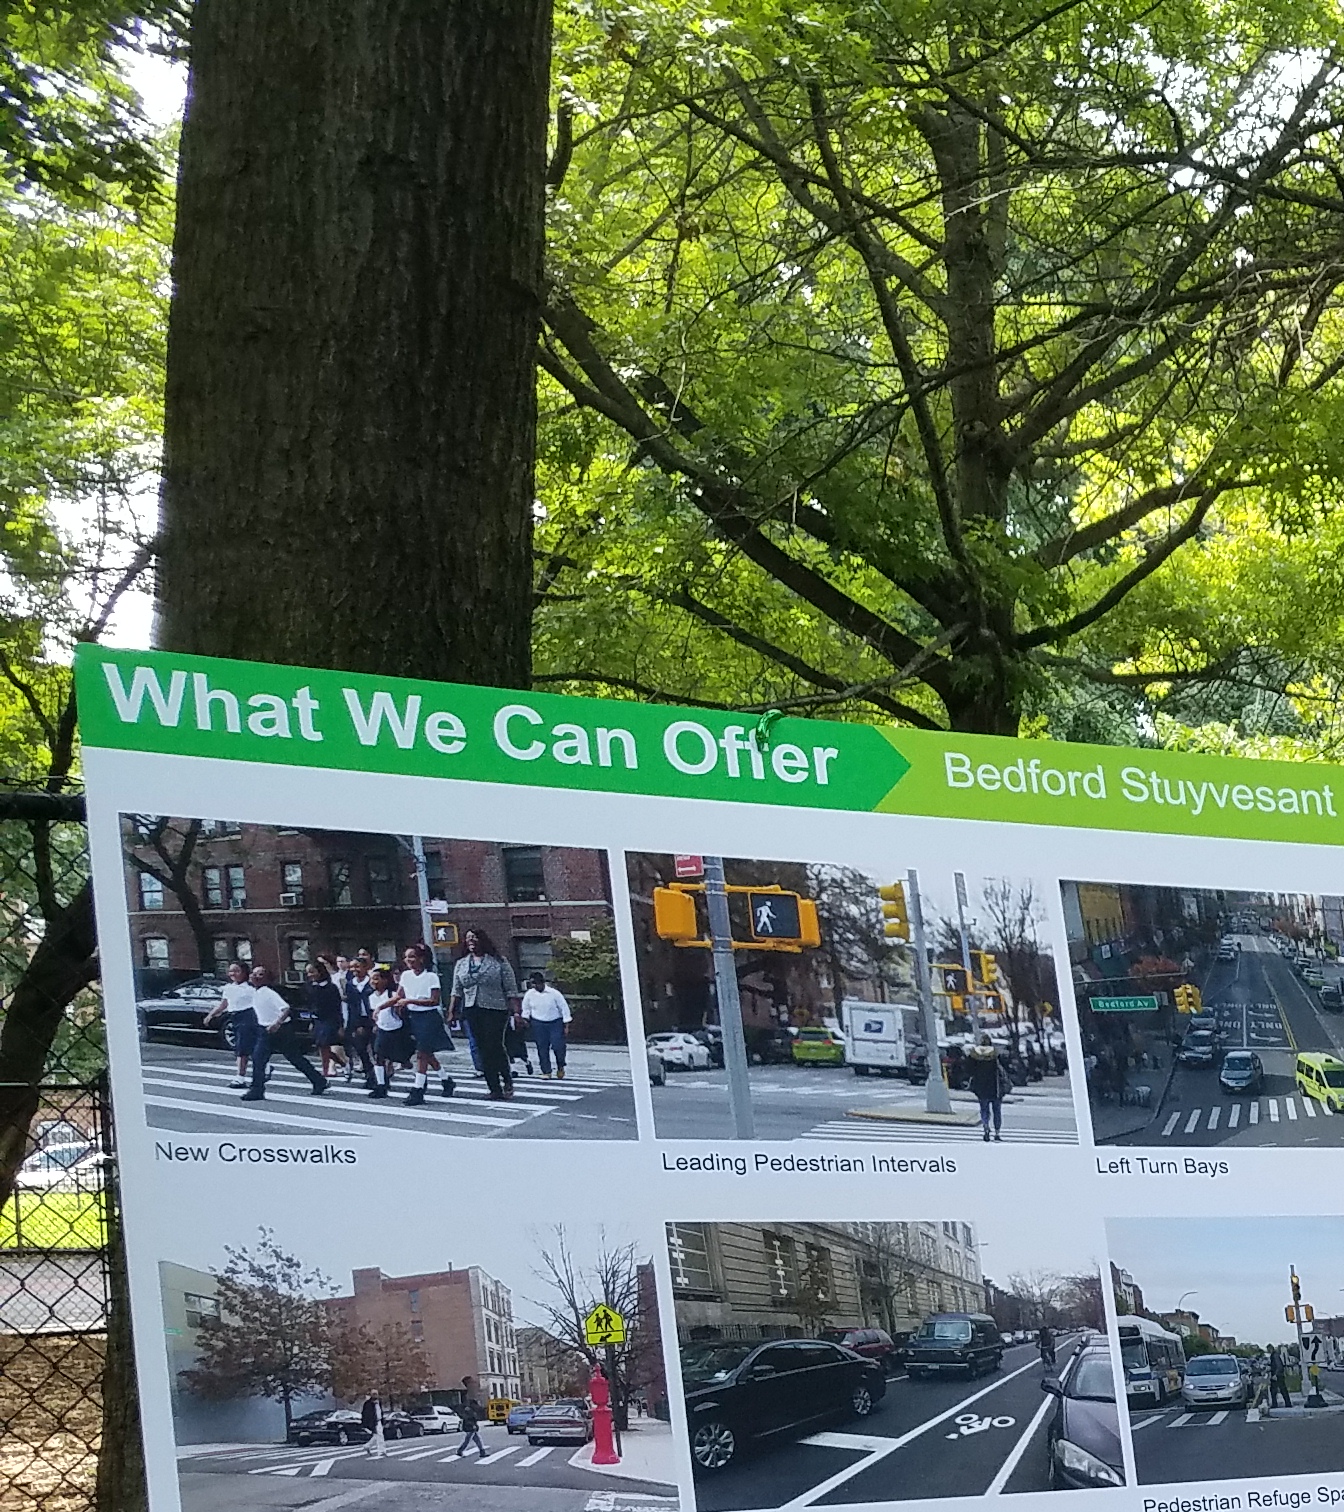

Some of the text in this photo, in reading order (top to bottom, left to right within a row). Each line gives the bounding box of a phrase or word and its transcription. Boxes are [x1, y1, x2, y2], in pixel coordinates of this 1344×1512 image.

[101, 662, 838, 784] What We Can Offer
[944, 752, 1336, 816] Bedford Stuyvesant
[156, 1142, 356, 1163] New Crosswalks
[662, 1153, 956, 1175] Leading Pedestrian Intervals
[1096, 1157, 1228, 1177] Left Turn Bays
[1248, 1490, 1310, 1508] Refuge
